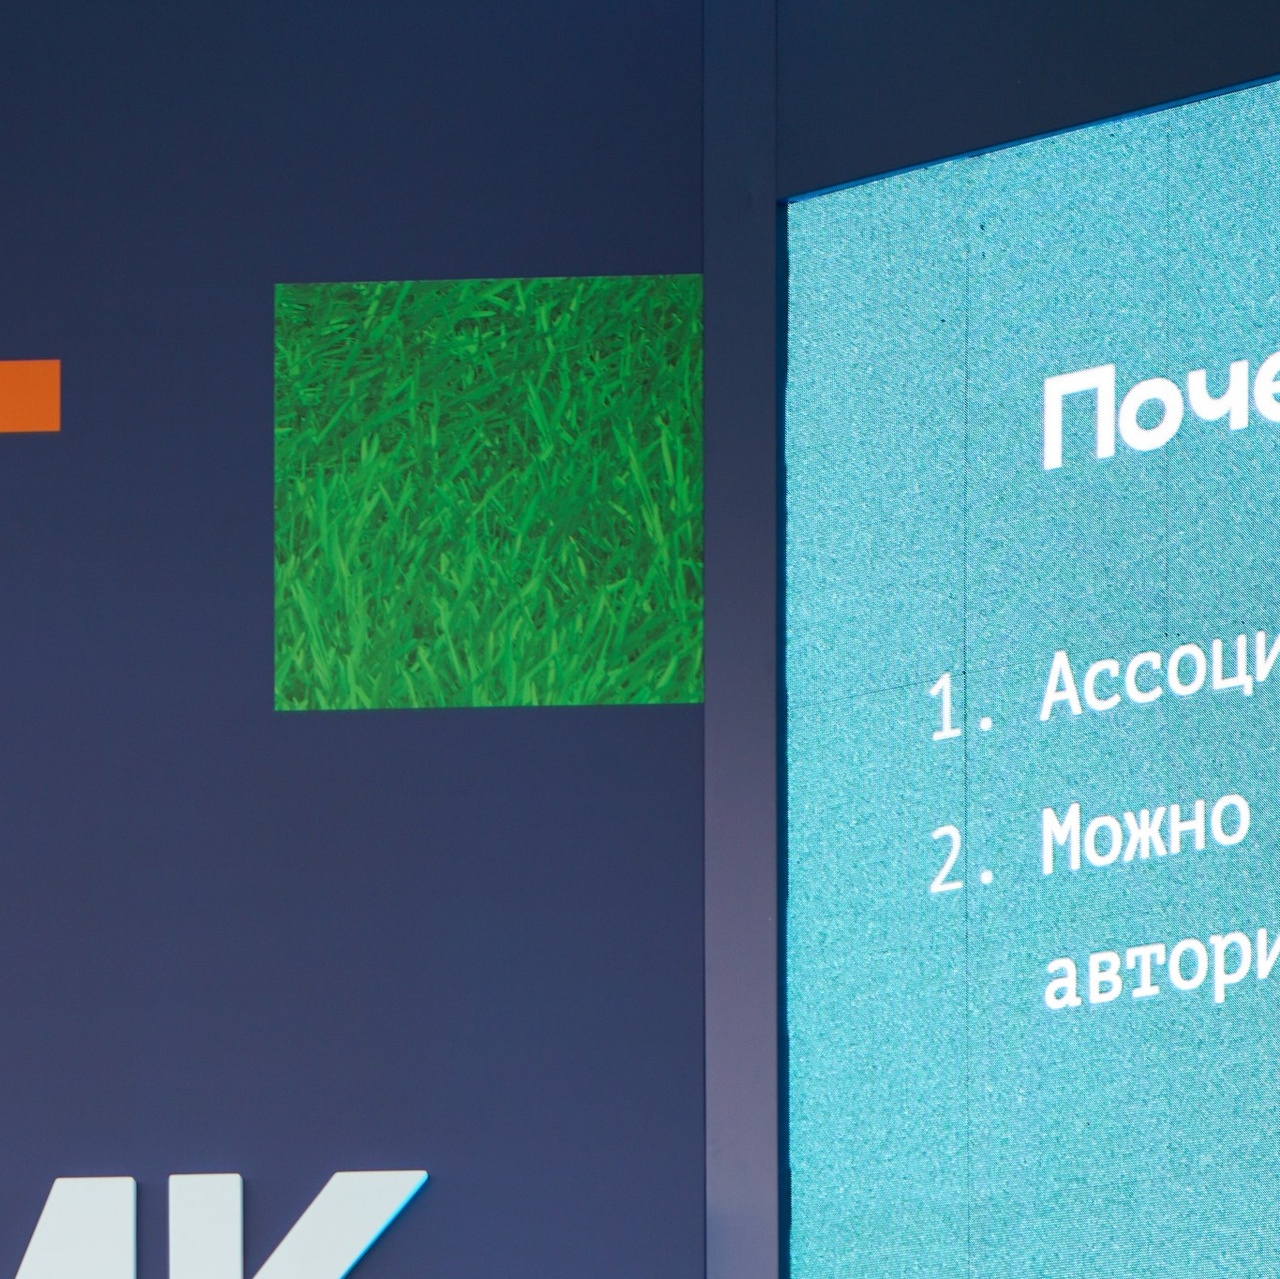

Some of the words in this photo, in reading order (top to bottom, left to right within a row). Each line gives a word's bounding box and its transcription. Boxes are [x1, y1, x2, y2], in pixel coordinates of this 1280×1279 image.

[929, 673, 993, 741] 1.
[929, 824, 993, 894] 2.
[1041, 793, 1251, 875] Можно
